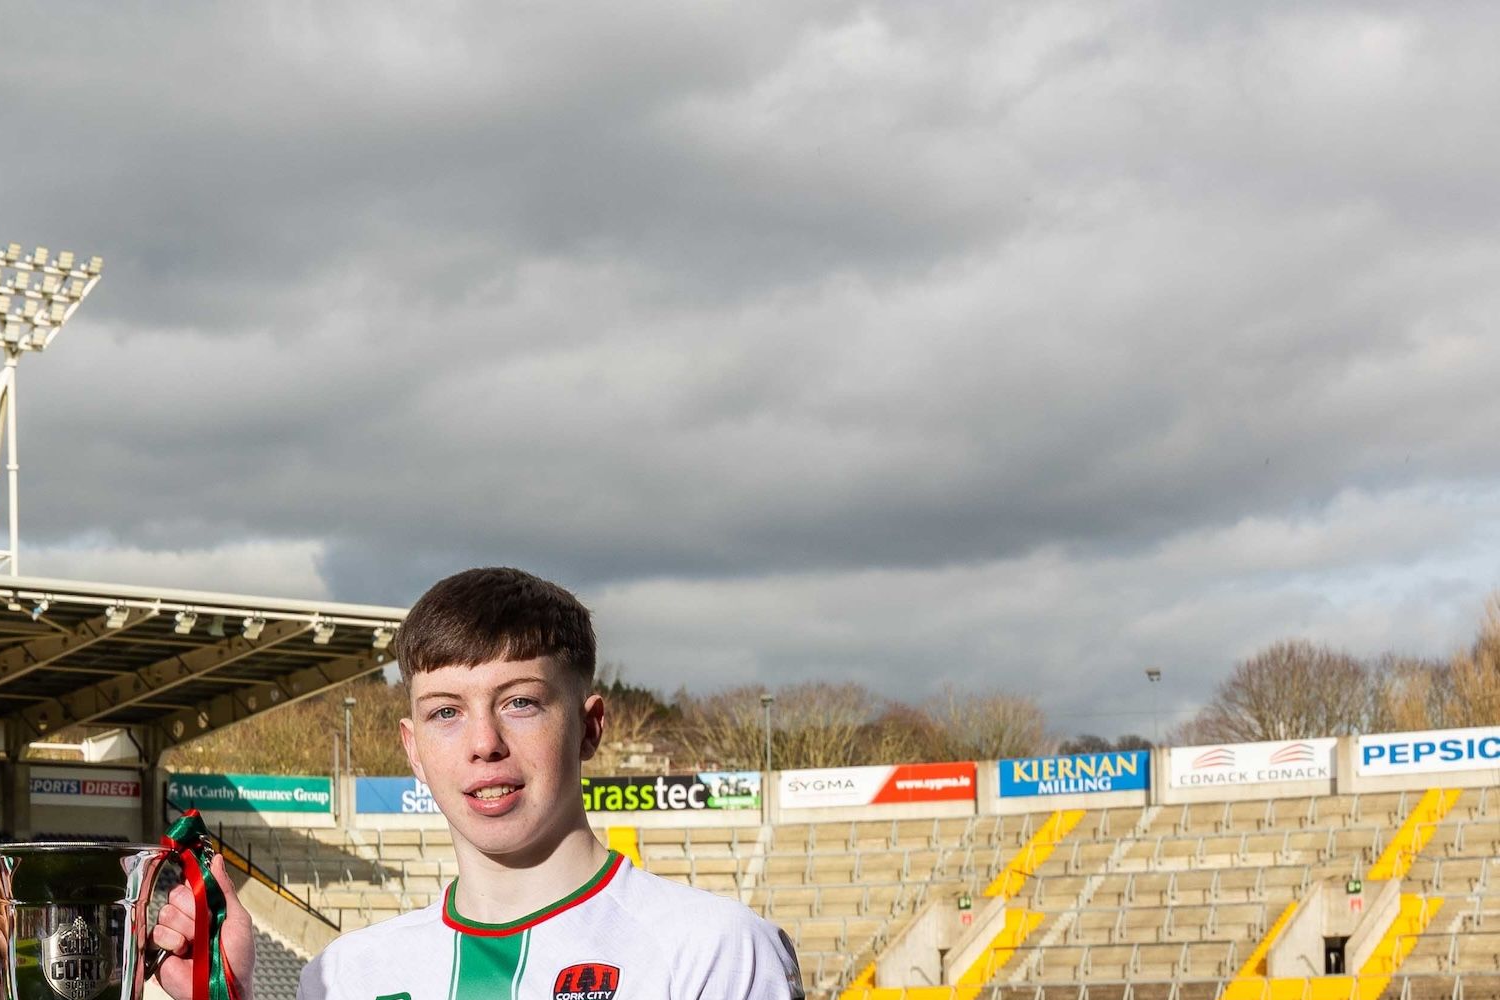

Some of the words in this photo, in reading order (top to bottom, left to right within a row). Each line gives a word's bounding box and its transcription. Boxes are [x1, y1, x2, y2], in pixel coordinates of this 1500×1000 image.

[1012, 753, 1137, 783] KIERNAN
[1180, 772, 1249, 785] CONACK
[1257, 767, 1328, 780] CONACK
[85, 782, 136, 795] DIRECT
[581, 776, 705, 811] Grasstec
[788, 779, 855, 792] SYGMA
[1038, 776, 1112, 794] MILLING
[181, 785, 236, 800] McCarthy
[238, 786, 292, 801] Insurance
[293, 788, 329, 805] Group
[556, 992, 585, 1000] CORK
[587, 991, 612, 999] CITY
